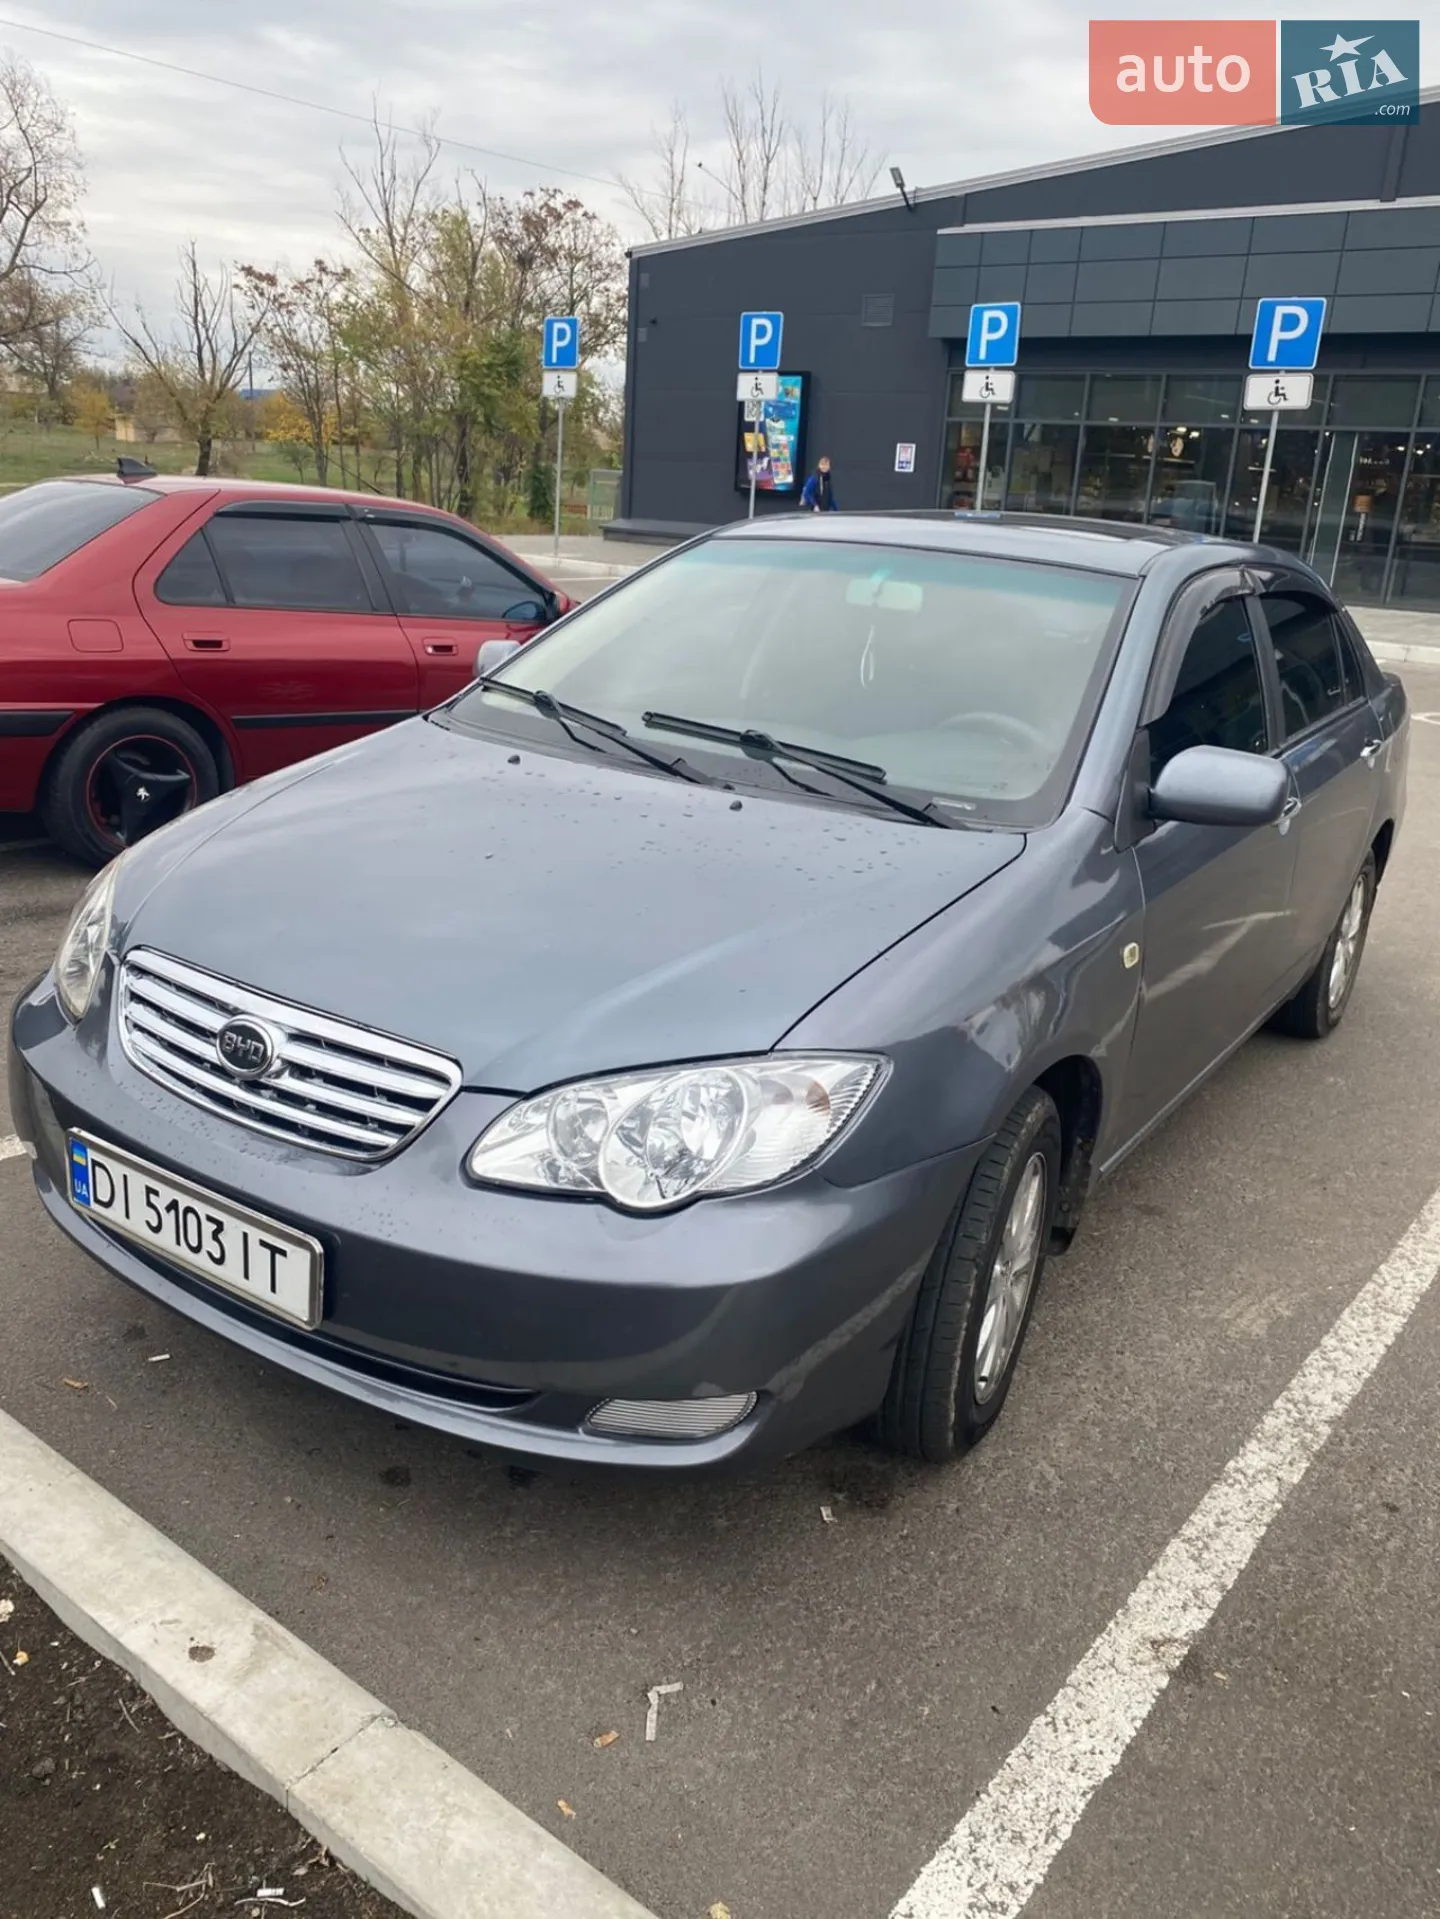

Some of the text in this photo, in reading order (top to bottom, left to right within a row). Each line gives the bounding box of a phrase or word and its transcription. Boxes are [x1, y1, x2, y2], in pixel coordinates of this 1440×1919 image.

[552, 322, 572, 364] P
[750, 318, 773, 364] P
[979, 310, 1008, 360] P
[1267, 305, 1309, 362] P
[74, 1178, 89, 1197] UA
[91, 1157, 288, 1295] DI 5103 IT
